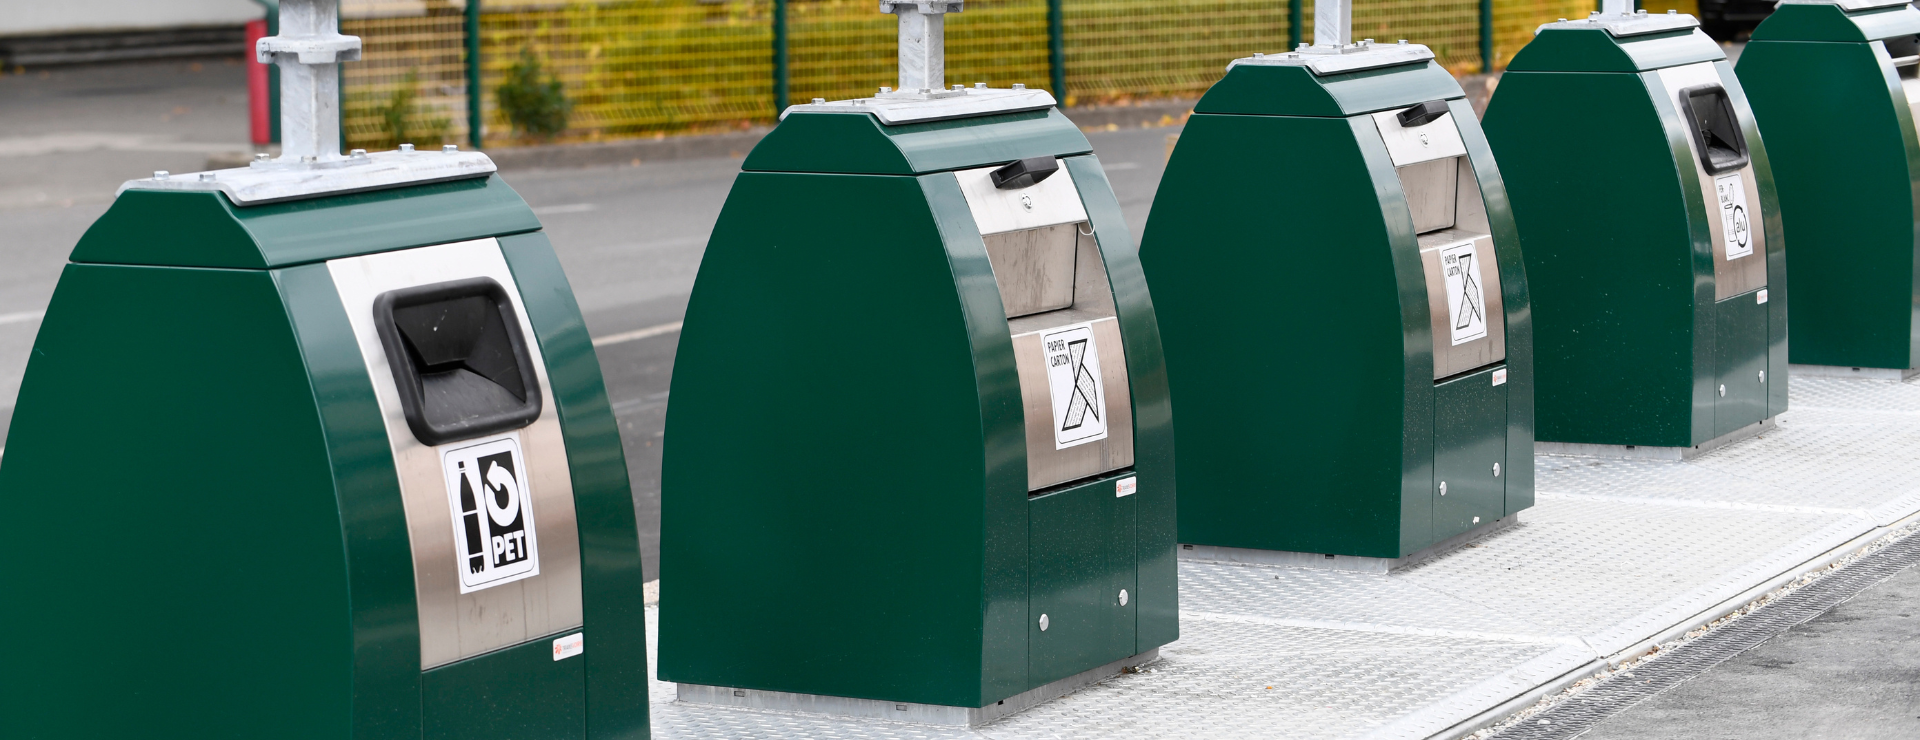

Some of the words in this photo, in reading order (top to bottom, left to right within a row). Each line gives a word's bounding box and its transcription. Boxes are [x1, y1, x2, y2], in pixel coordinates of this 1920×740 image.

[1736, 217, 1745, 233] alu
[1444, 253, 1457, 265] PAPIER
[1447, 265, 1460, 277] CARTON
[1047, 339, 1066, 353] PAPIER
[1050, 352, 1070, 368] CARTON
[491, 529, 525, 565] PET
